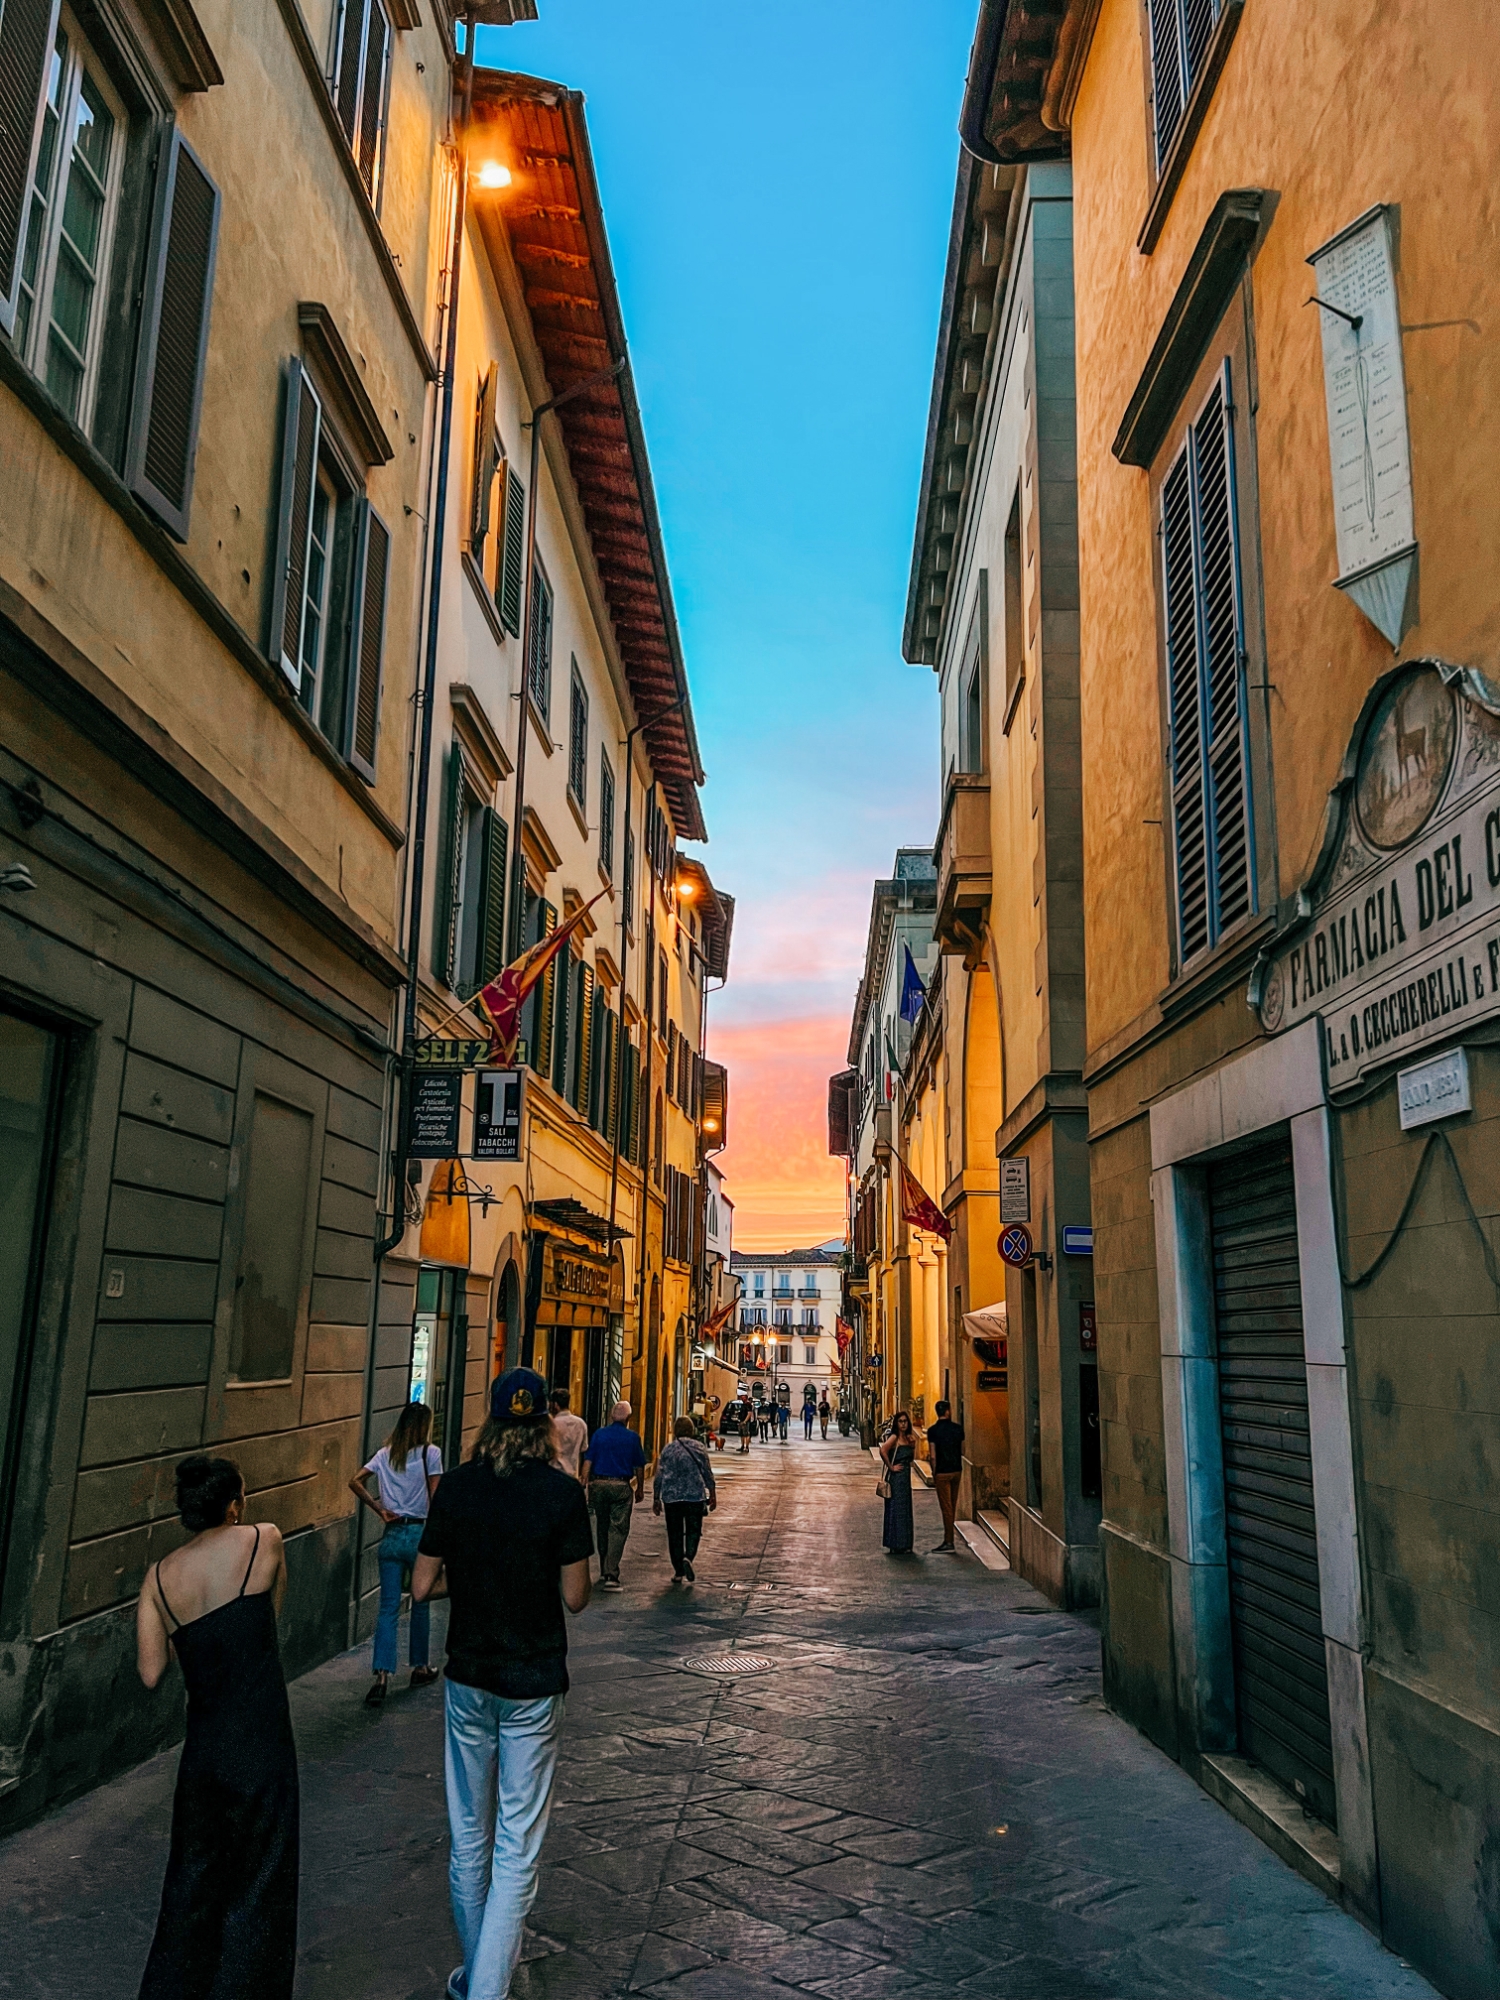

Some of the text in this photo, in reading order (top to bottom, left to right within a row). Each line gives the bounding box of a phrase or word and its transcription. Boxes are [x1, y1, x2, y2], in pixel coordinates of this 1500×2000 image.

[1290, 879, 1406, 1008] FARMACIA
[1416, 834, 1472, 932] DEL
[1363, 956, 1468, 1050] CECCHERELLI
[414, 1041, 471, 1063] SELF
[482, 1072, 518, 1126] T
[478, 1138, 516, 1147] TABACCHI
[489, 1128, 506, 1136] SALI
